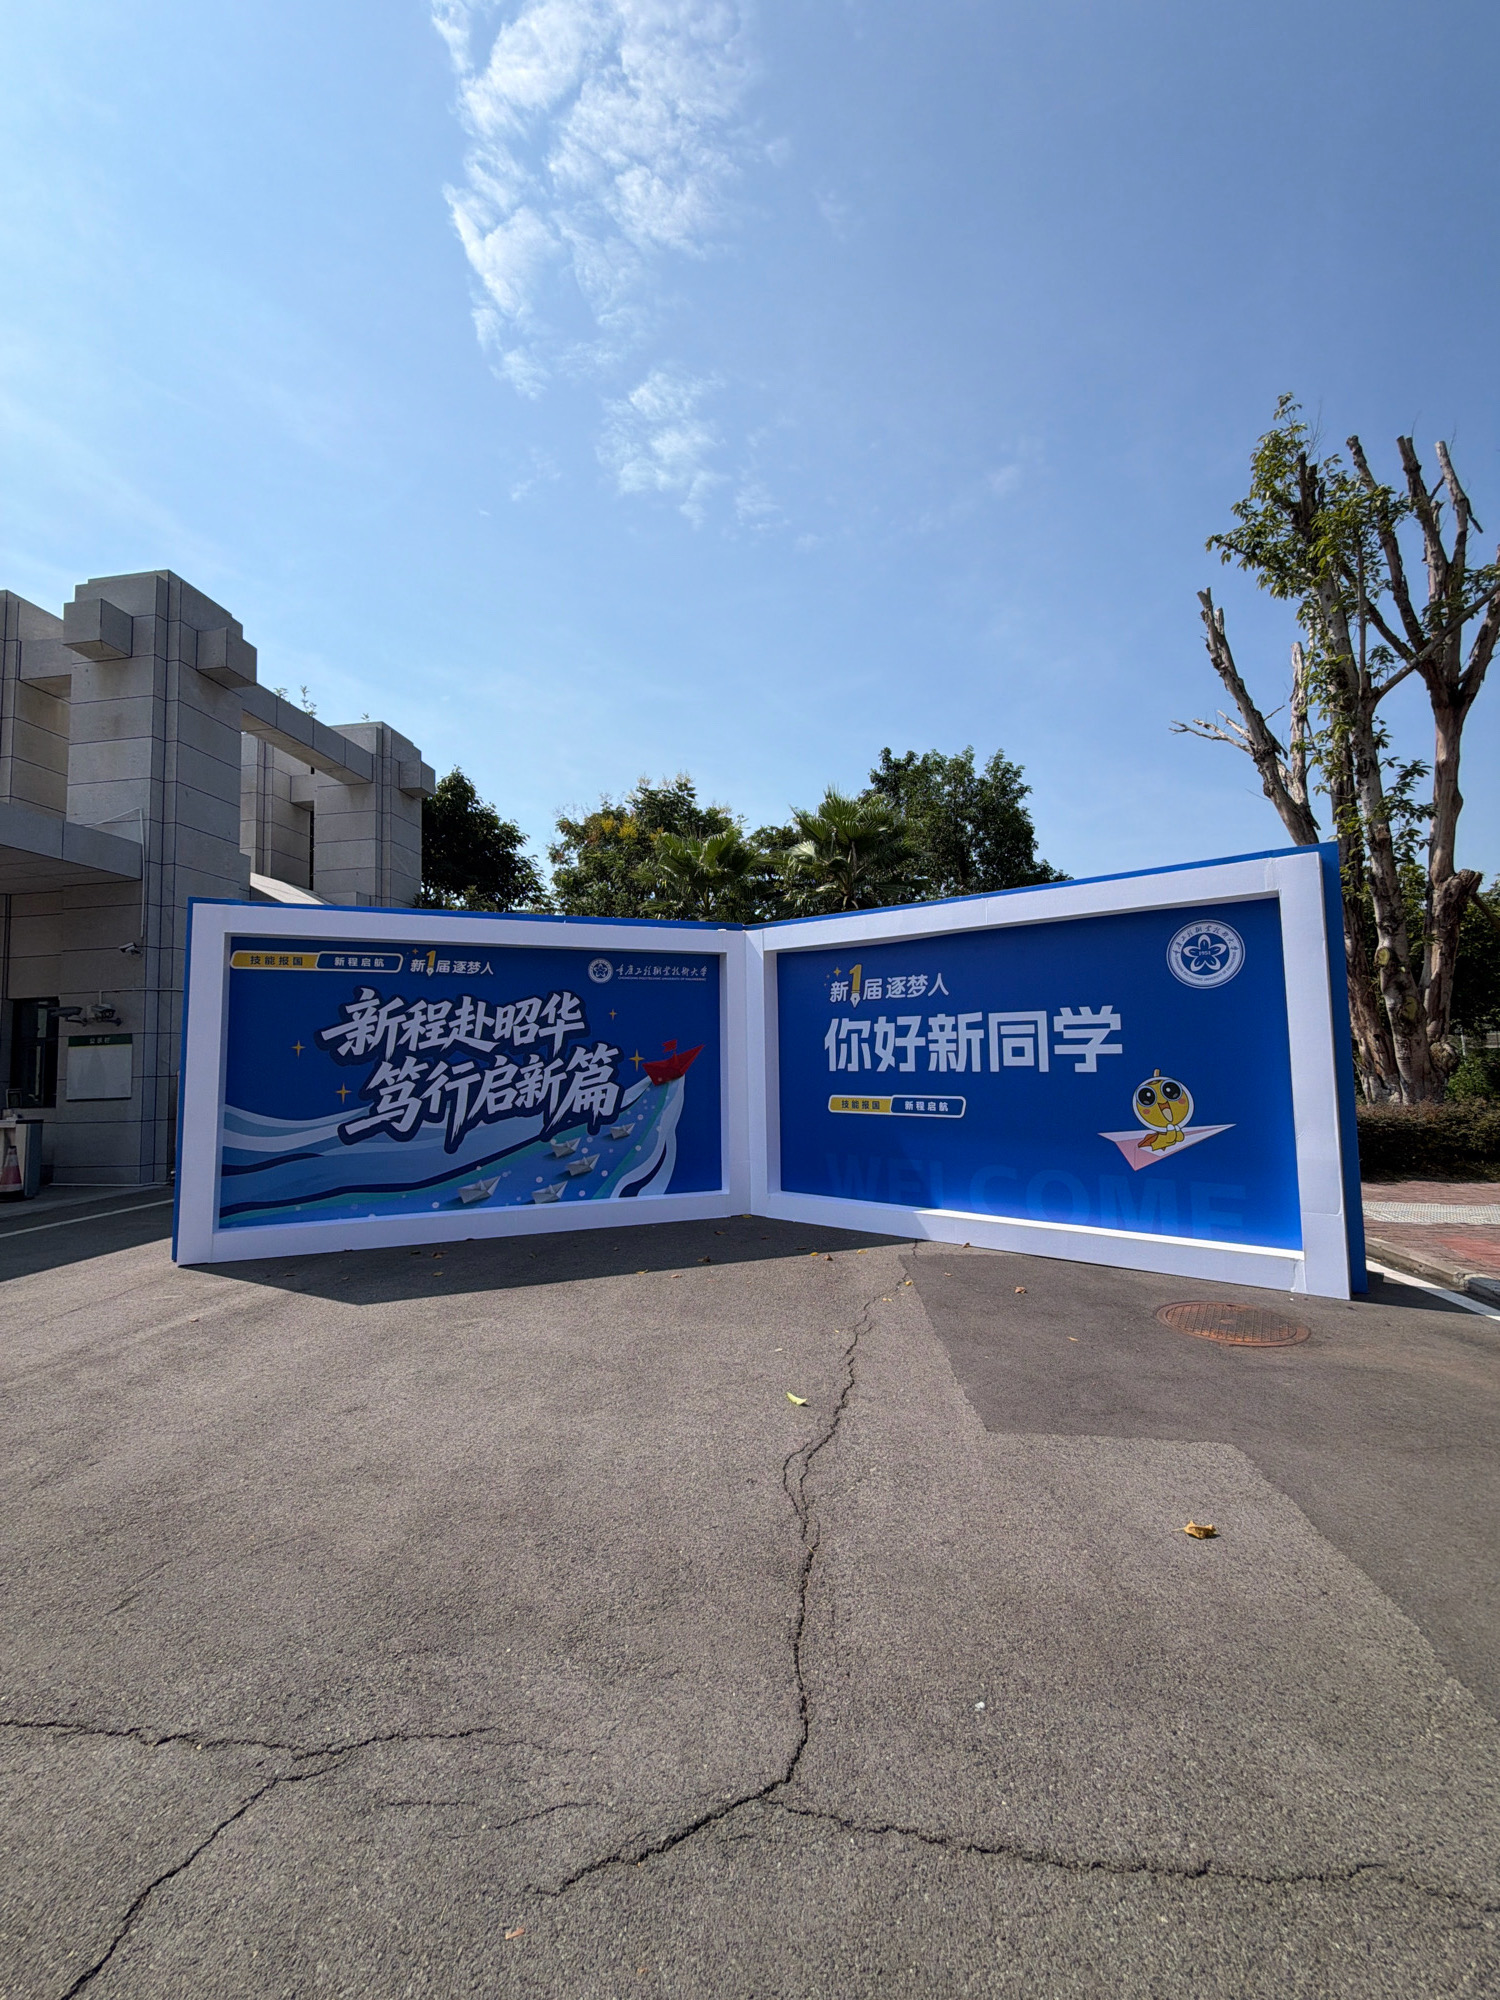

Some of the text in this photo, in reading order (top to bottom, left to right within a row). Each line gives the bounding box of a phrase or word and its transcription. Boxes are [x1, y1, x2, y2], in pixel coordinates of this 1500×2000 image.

[250, 955, 385, 968] 技能报国 新程启航
[321, 987, 586, 1061] 新程赴昭华
[824, 1005, 1123, 1073] 你好新同学
[345, 1043, 620, 1143] 笃行启新篇
[841, 1099, 949, 1112] 技能报国 新程启航
